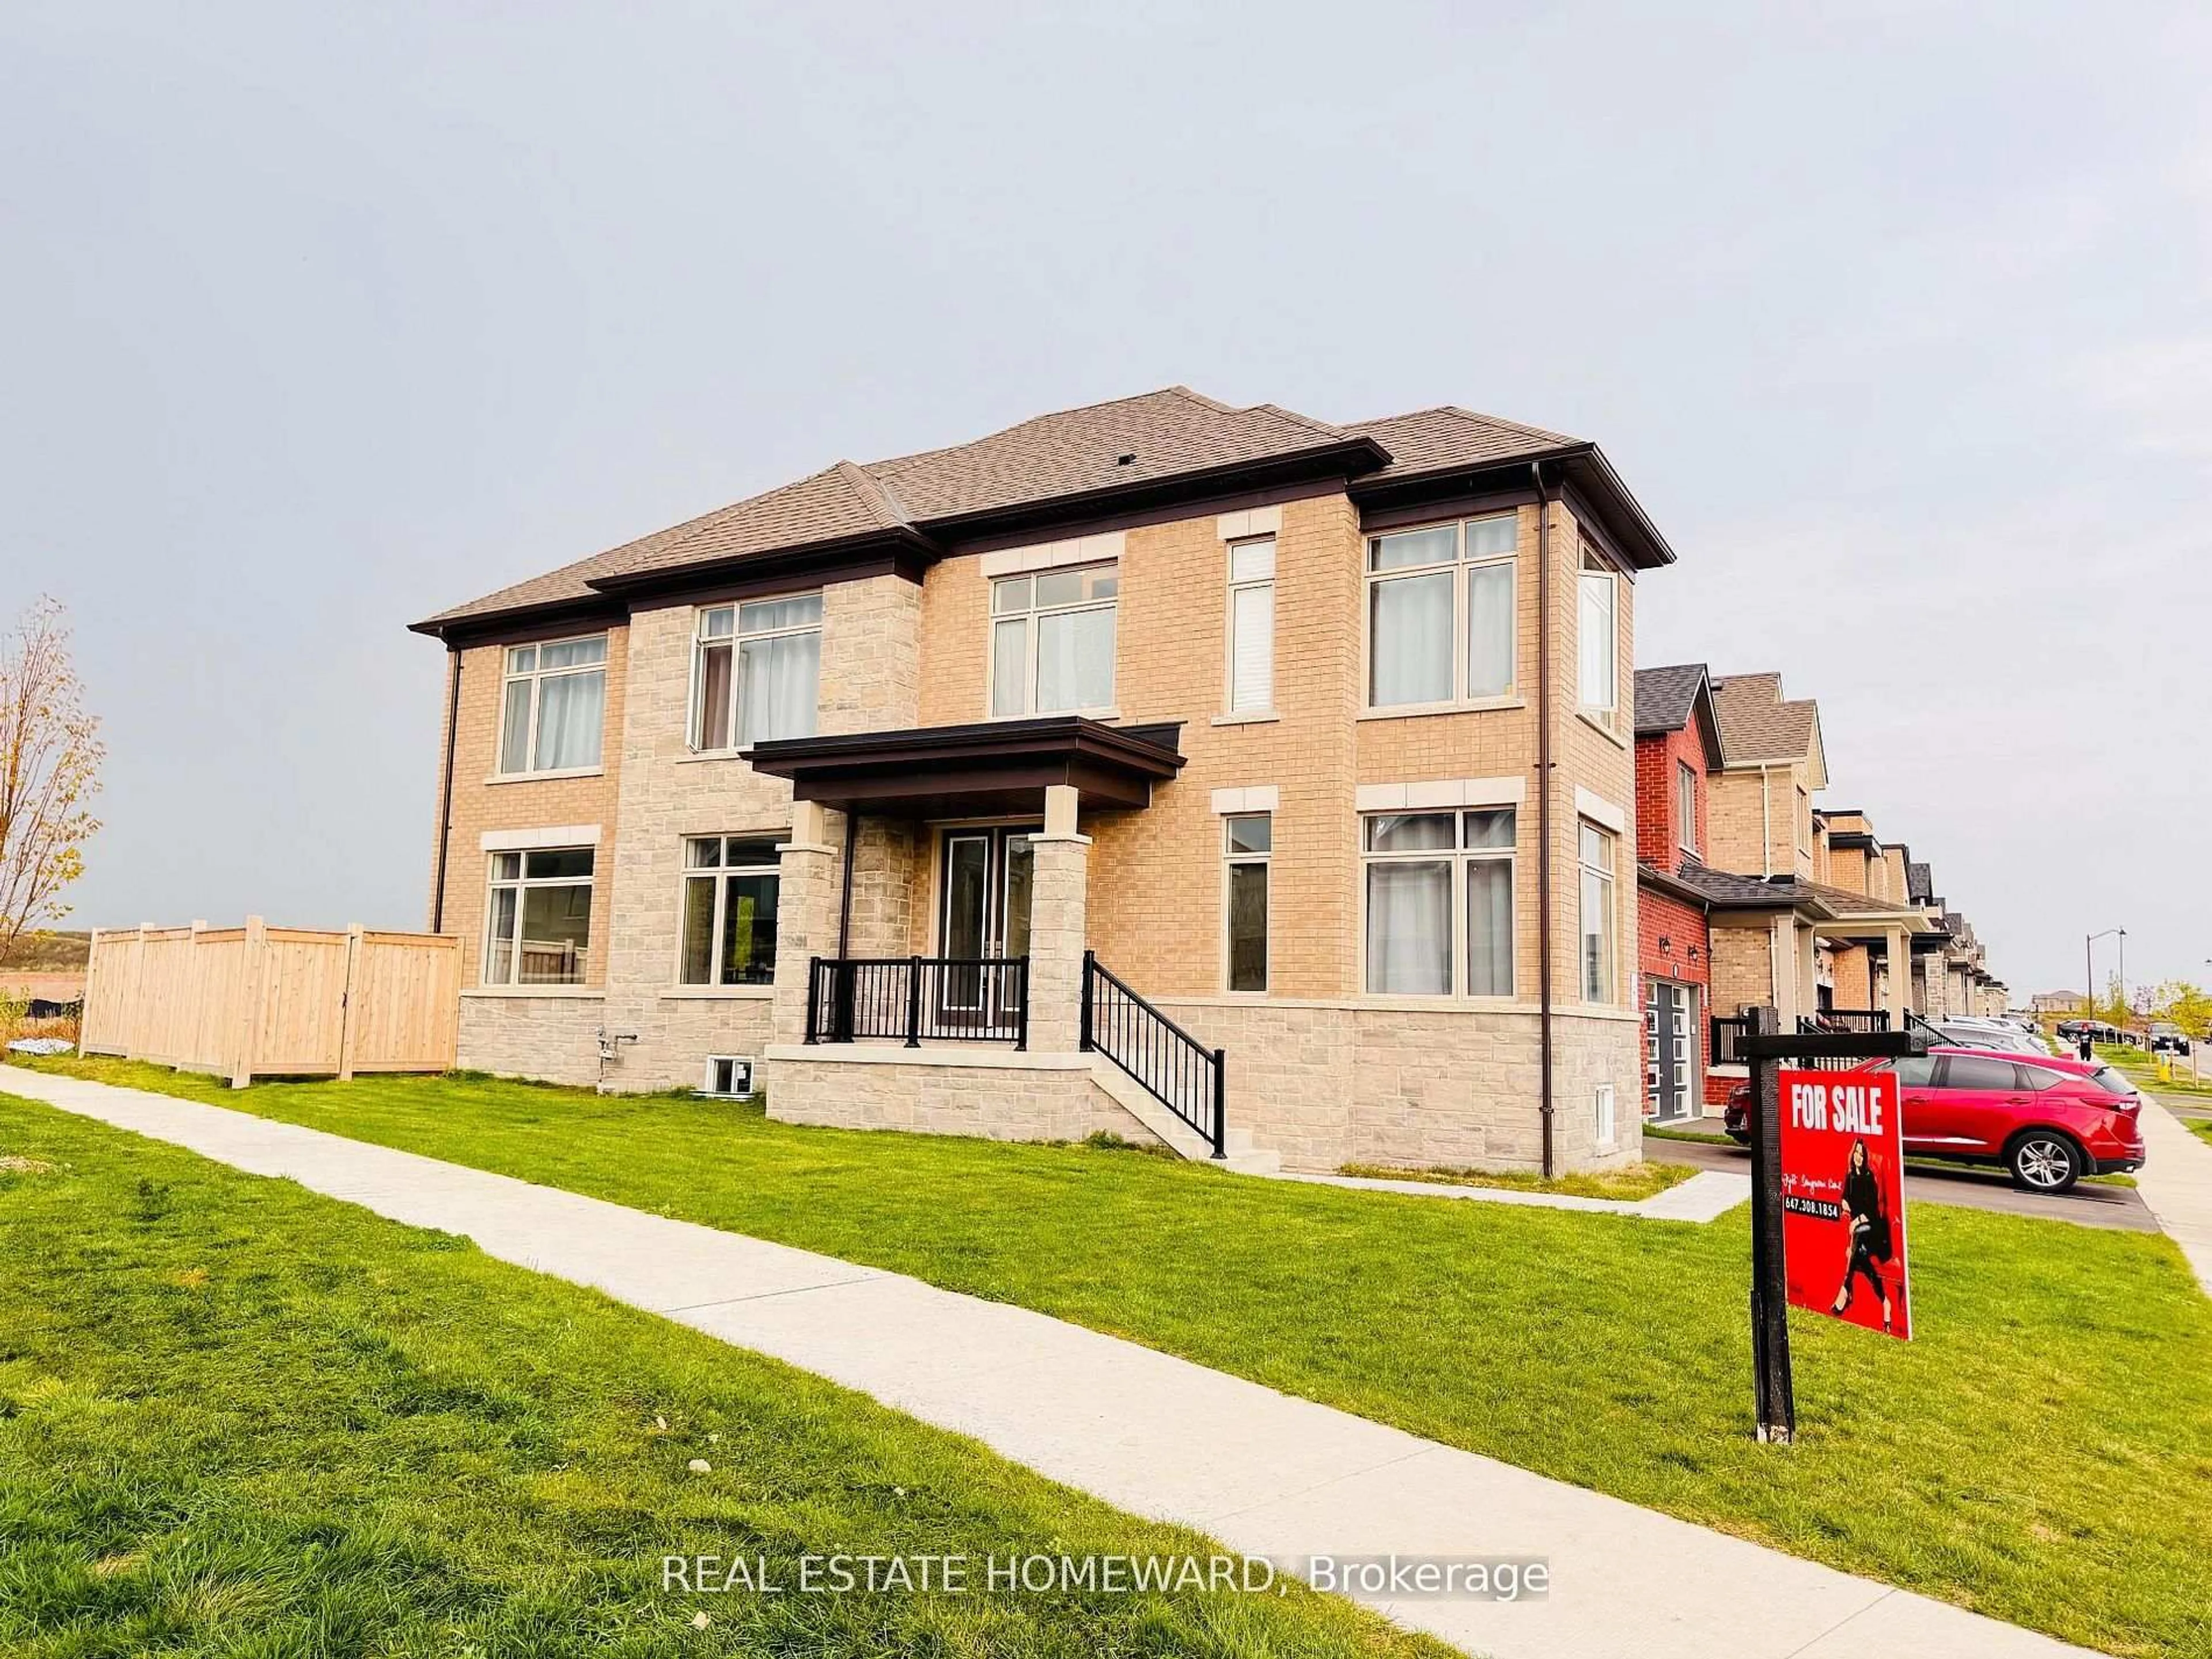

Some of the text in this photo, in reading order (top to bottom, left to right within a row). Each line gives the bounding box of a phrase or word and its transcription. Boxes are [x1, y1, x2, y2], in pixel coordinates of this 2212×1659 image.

[1791, 1083, 1884, 1136] FOR SALE
[1785, 1196, 1838, 1218] 647.308.1854
